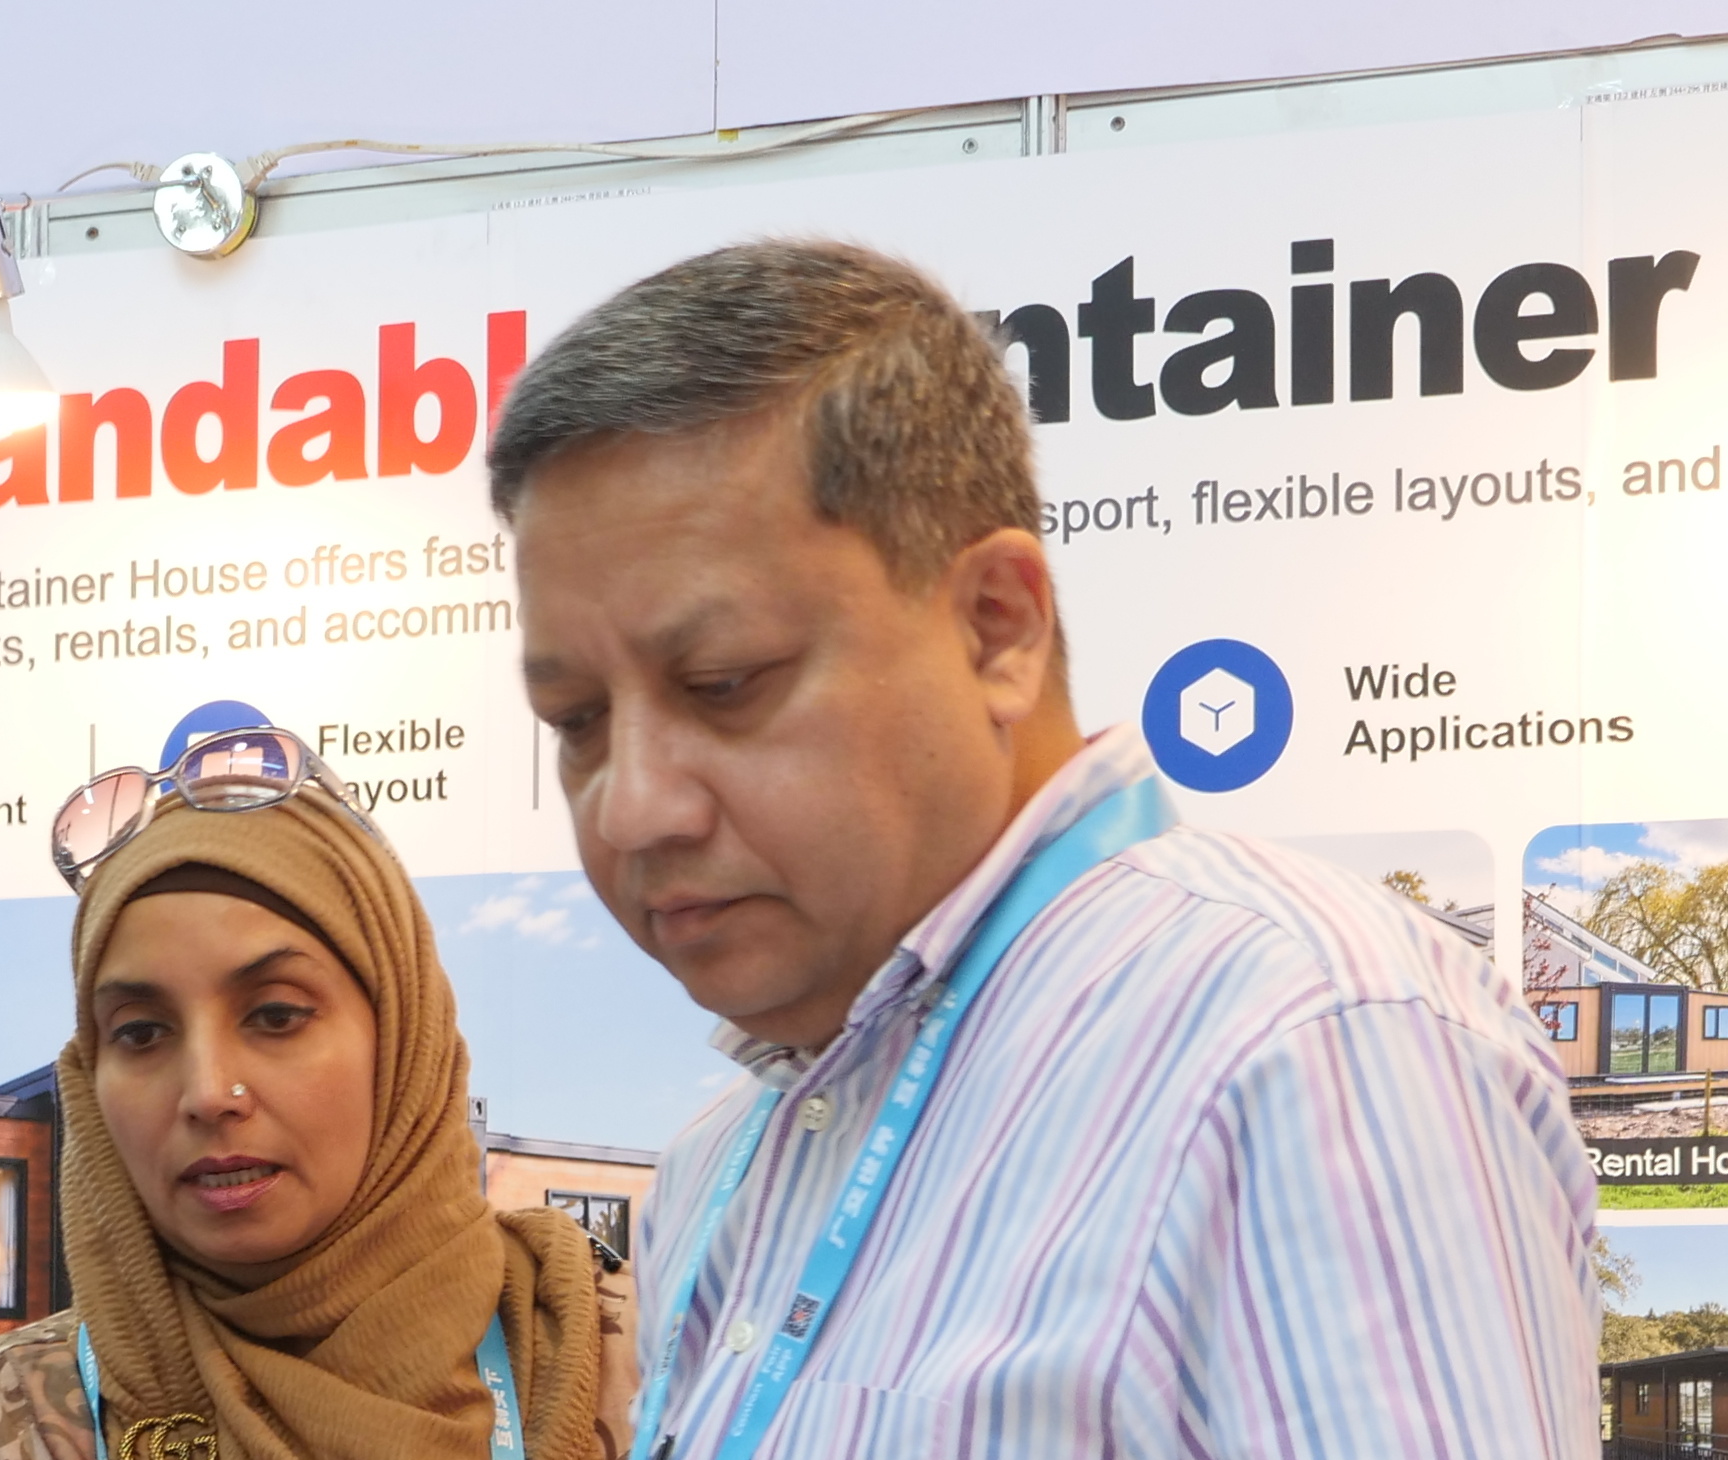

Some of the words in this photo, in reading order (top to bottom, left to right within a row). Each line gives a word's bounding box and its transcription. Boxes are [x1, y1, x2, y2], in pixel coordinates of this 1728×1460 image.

[976, 239, 1701, 423] ntainer
[130, 555, 266, 600] House
[283, 544, 407, 586] offers
[424, 534, 505, 575] fast
[1039, 484, 1173, 544] sport,
[1193, 472, 1374, 529] flexible
[1394, 457, 1596, 521] layouts,
[1623, 446, 1722, 495] and
[53, 614, 209, 663] rentals,
[227, 607, 307, 648] and
[325, 601, 515, 643] accomm
[1344, 661, 1456, 702] Wide
[318, 718, 466, 756] Flexible
[1344, 709, 1634, 760] Applications
[347, 769, 448, 813] ayout
[1589, 1146, 1680, 1178] Rental
